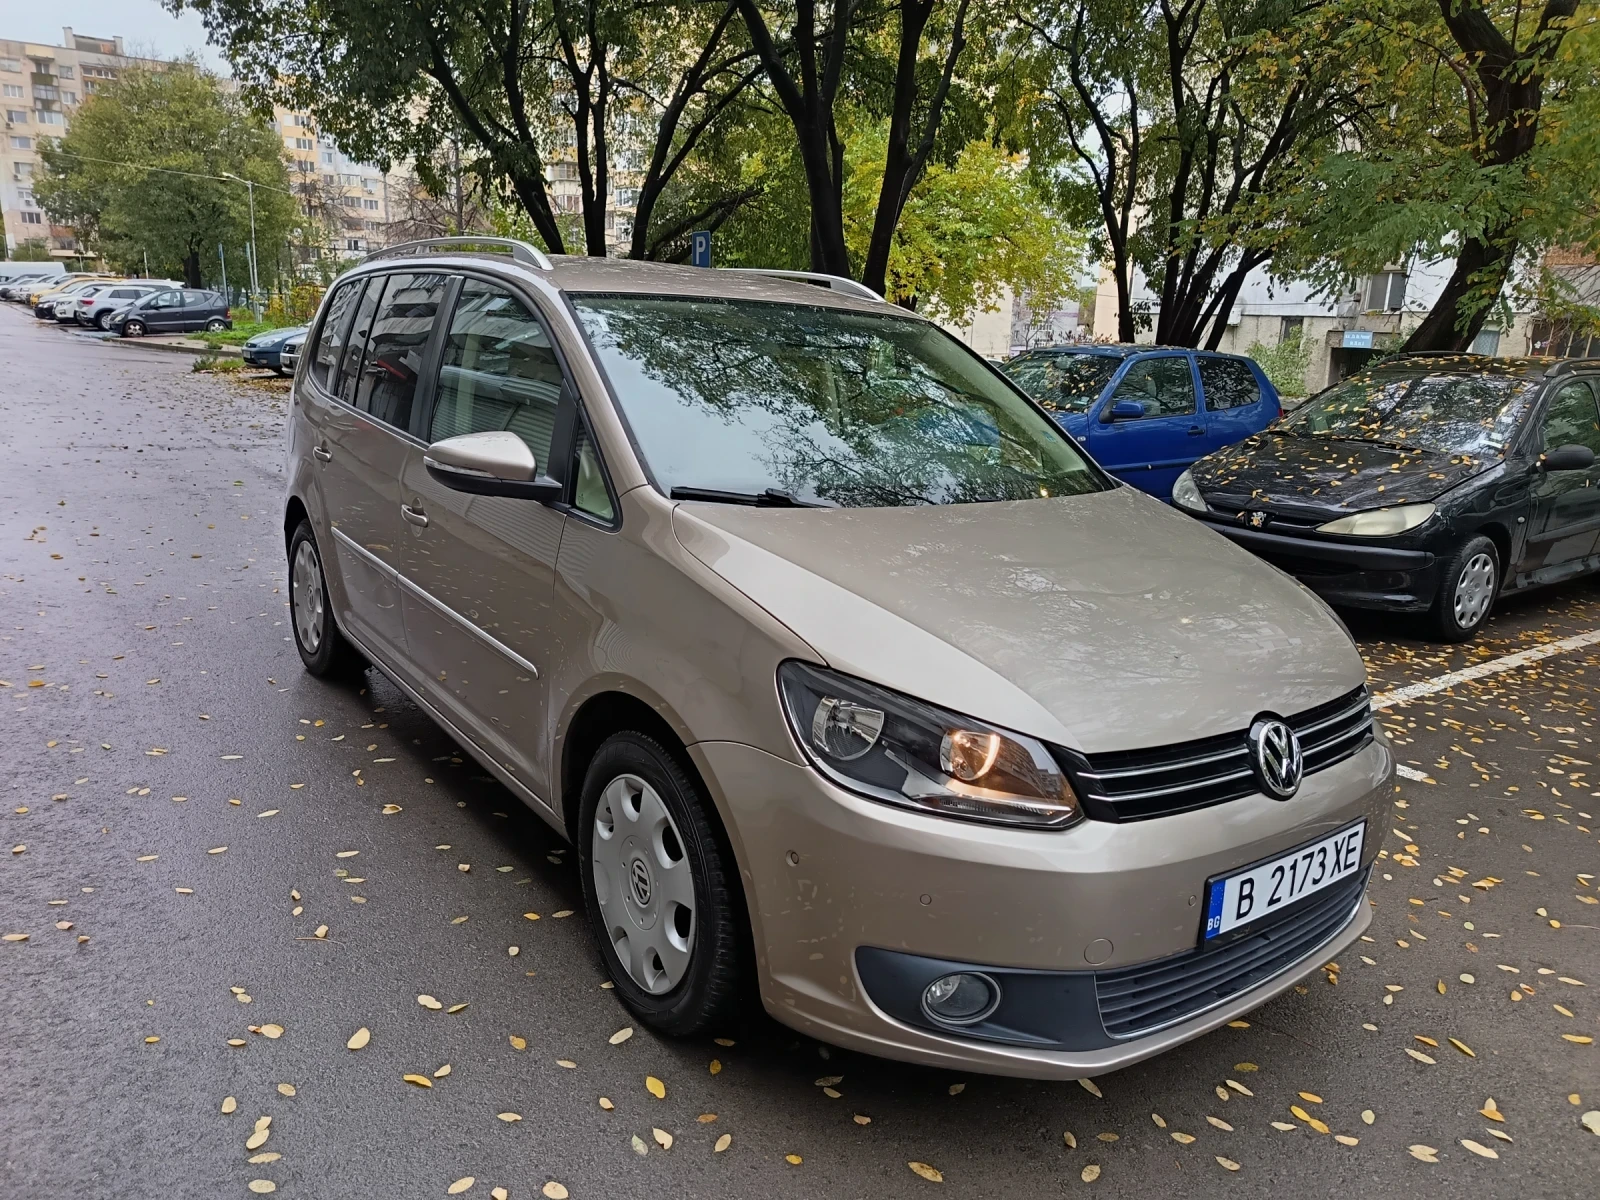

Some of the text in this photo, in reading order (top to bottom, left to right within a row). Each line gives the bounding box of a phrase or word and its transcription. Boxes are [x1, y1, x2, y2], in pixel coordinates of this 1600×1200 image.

[696, 236, 706, 265] P
[1236, 877, 1255, 921] B
[1207, 915, 1221, 931] BG
